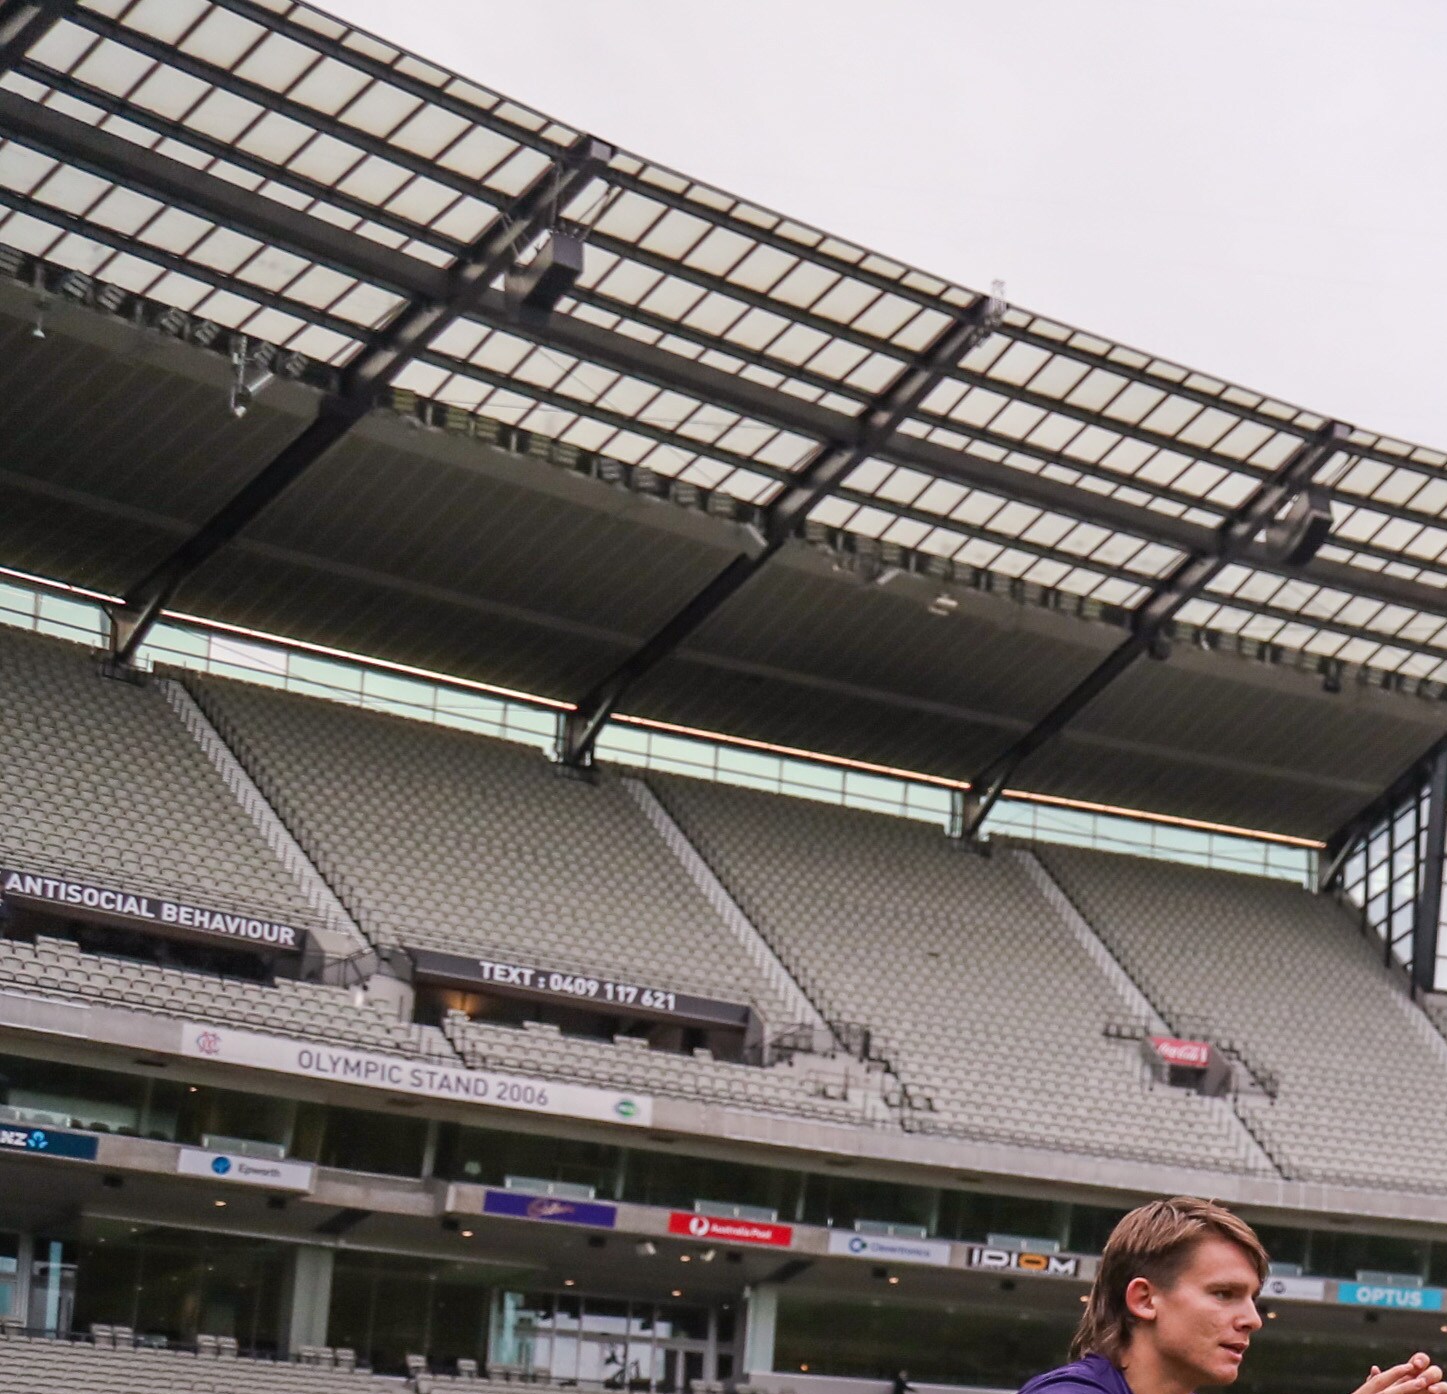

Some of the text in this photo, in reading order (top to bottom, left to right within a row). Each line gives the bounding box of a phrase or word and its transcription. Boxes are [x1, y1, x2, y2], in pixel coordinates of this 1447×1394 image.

[5, 872, 296, 946] ANTISOCIAL BEHAVIOUR
[479, 960, 536, 987] TEXT
[550, 973, 599, 998] 0409
[604, 983, 638, 1004] 117
[641, 990, 676, 1011] 621
[299, 1049, 550, 1107] OLYMPIC STAND 2006
[711, 1224, 773, 1240] Australia Post
[970, 1249, 1076, 1276] IDIOM
[1356, 1285, 1423, 1307] OPTUS
